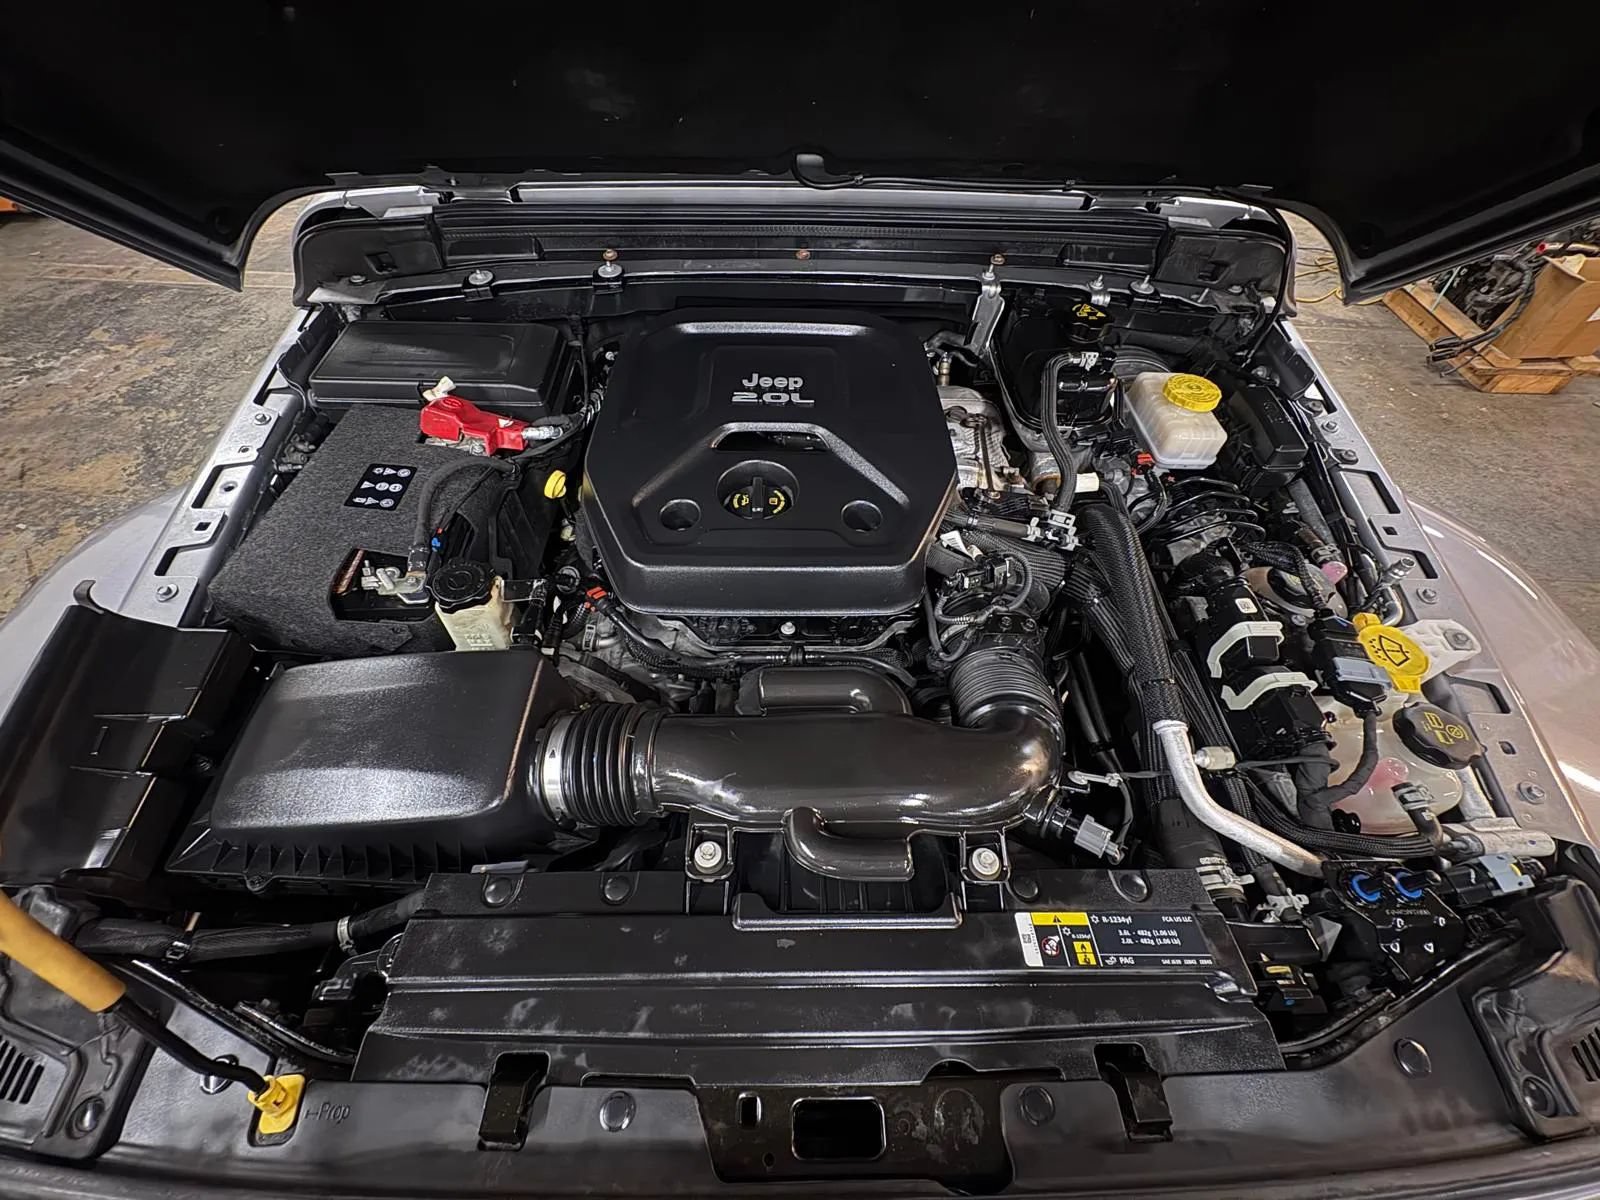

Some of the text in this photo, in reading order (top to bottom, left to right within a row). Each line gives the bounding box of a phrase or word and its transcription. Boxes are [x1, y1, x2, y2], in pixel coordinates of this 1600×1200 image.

[742, 373, 803, 390] Jeep
[732, 391, 815, 403] 2.0L
[1101, 915, 1132, 925] R-1234yf
[1119, 957, 1135, 965] PAG
